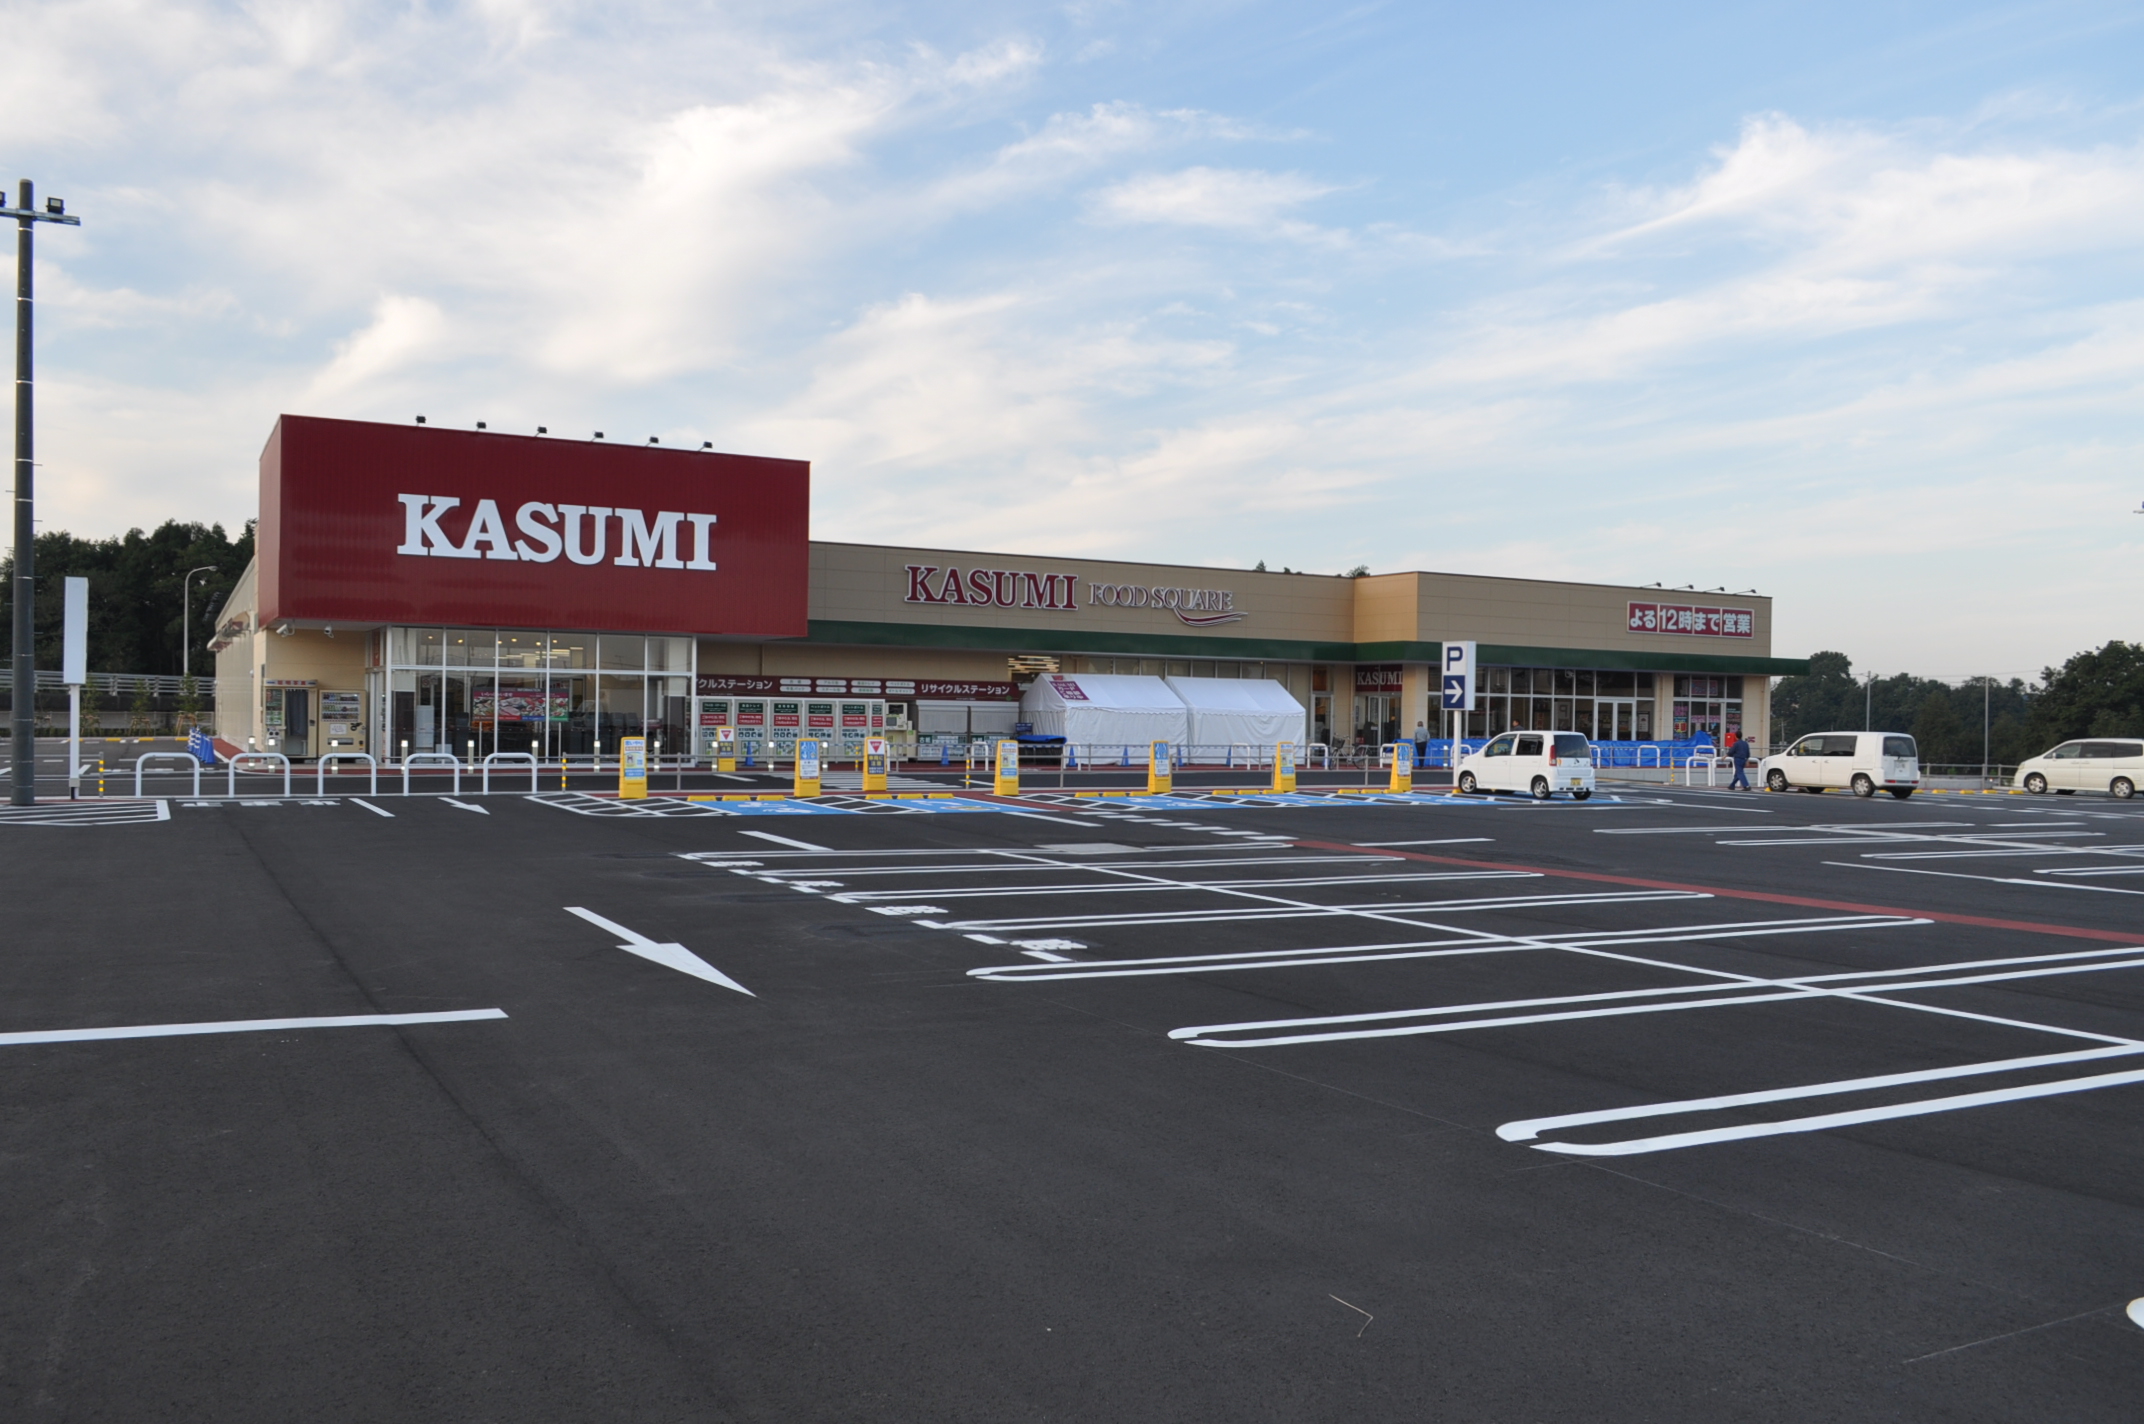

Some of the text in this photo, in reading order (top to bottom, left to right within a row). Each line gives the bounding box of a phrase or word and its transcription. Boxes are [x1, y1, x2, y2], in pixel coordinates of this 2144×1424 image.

[397, 493, 717, 571] KASUMI
[904, 564, 1235, 614] KASUMI FOOD SQUARE
[1629, 608, 1752, 634] よる12時まで営業
[1446, 646, 1464, 672] P
[695, 678, 773, 690] クルステーション
[921, 683, 1010, 695] リサイクルステーション
[1357, 671, 1403, 686] KASUMI
